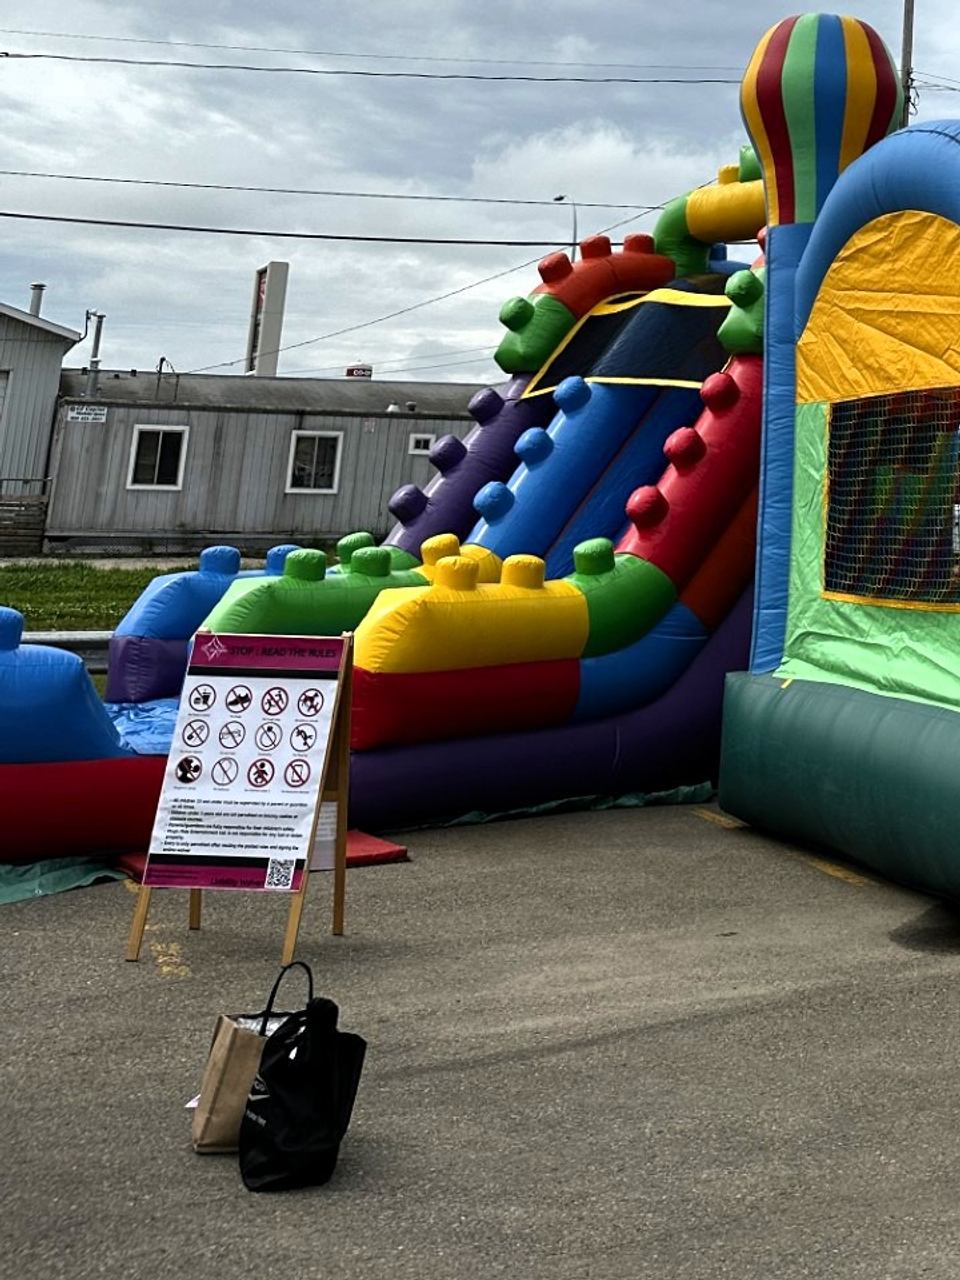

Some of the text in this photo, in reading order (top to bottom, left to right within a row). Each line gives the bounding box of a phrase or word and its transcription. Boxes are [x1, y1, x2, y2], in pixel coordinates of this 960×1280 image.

[229, 646, 254, 656] STOP
[261, 647, 287, 657] READ
[288, 647, 305, 657] THE
[308, 648, 337, 658] RULES
